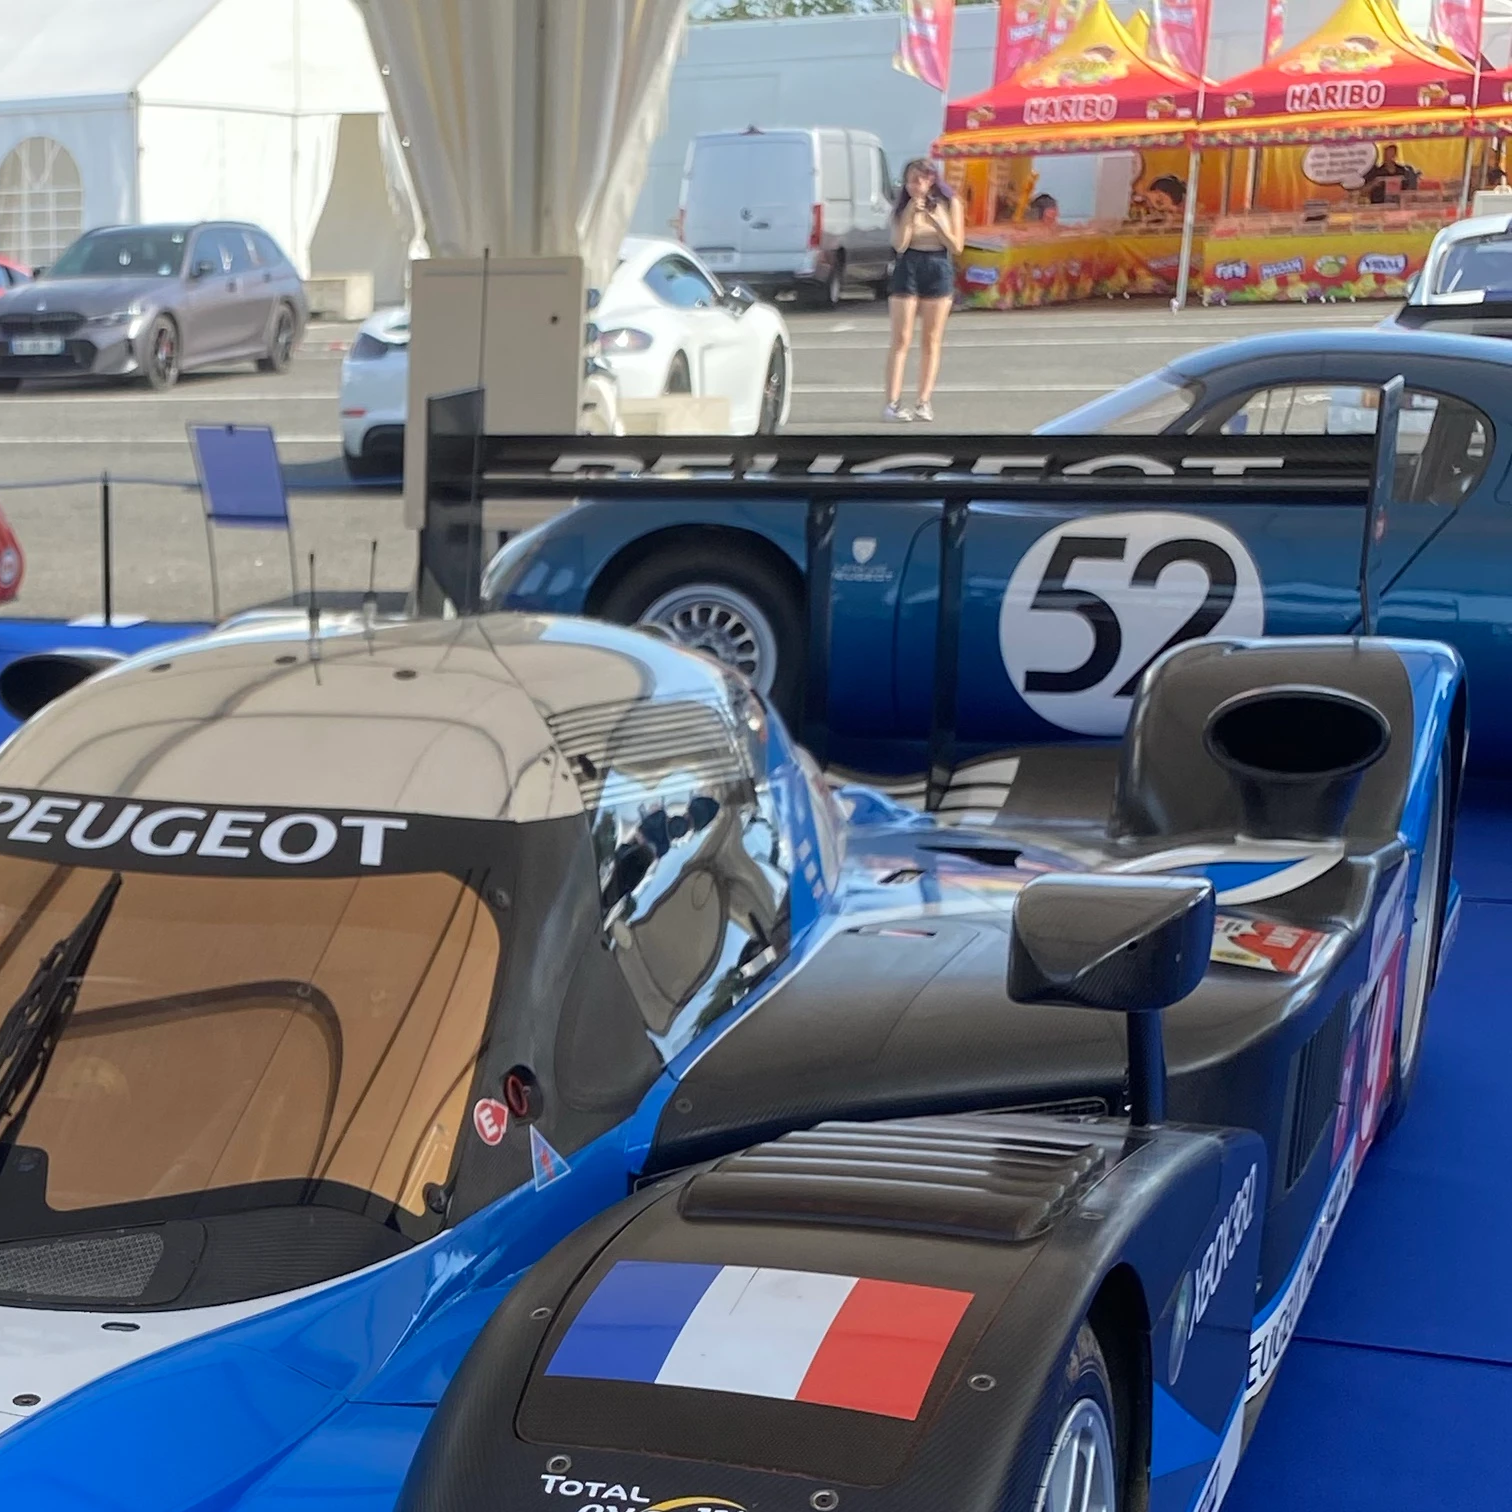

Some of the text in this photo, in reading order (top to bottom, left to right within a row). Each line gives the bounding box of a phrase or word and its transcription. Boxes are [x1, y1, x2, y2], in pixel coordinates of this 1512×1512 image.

[1024, 93, 1118, 125] HARIBO
[1286, 80, 1385, 113] HARIBO
[1024, 536, 1238, 698] 52
[540, 1474, 650, 1503] TOTAL
